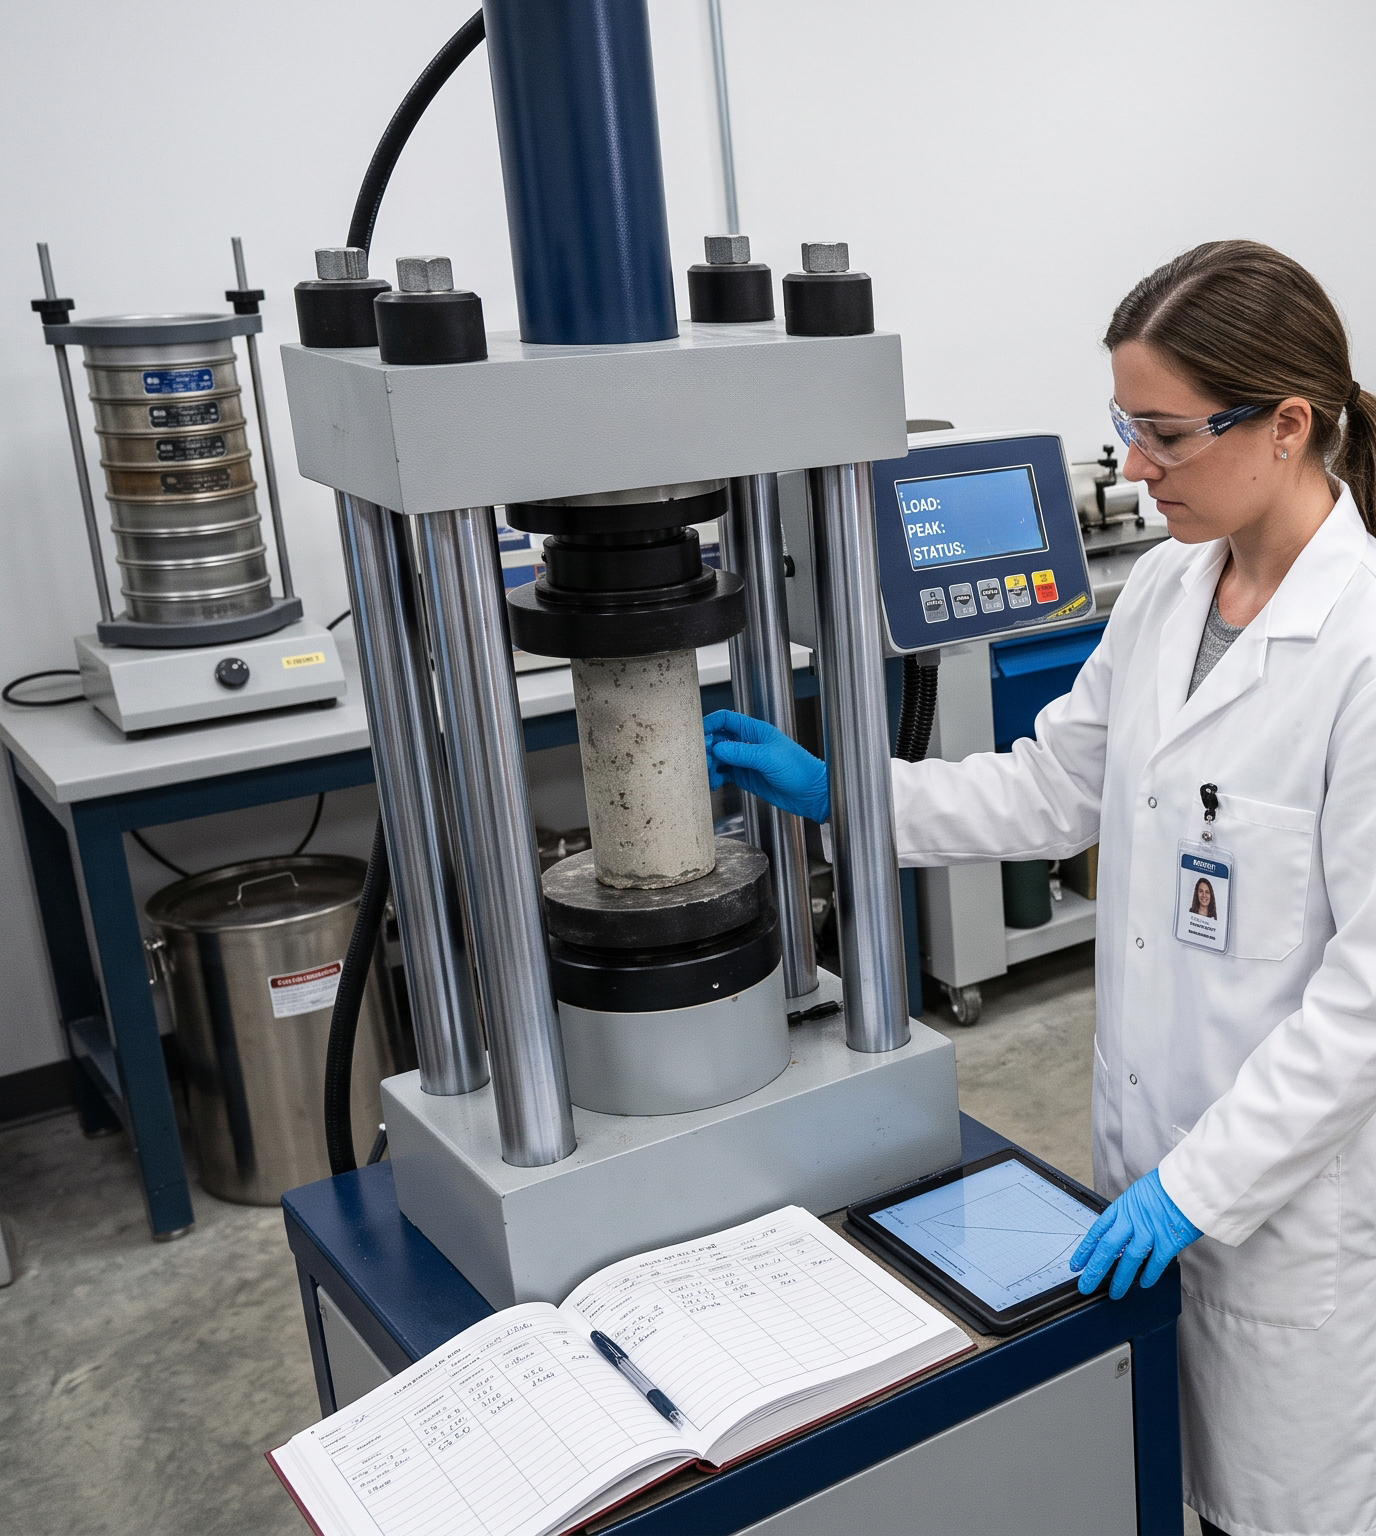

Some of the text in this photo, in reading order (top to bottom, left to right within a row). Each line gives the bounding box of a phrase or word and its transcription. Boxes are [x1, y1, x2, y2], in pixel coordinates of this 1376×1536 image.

[902, 497, 941, 515] LOAD:
[907, 521, 946, 539] PEAK:
[913, 541, 966, 561] STATUS:
